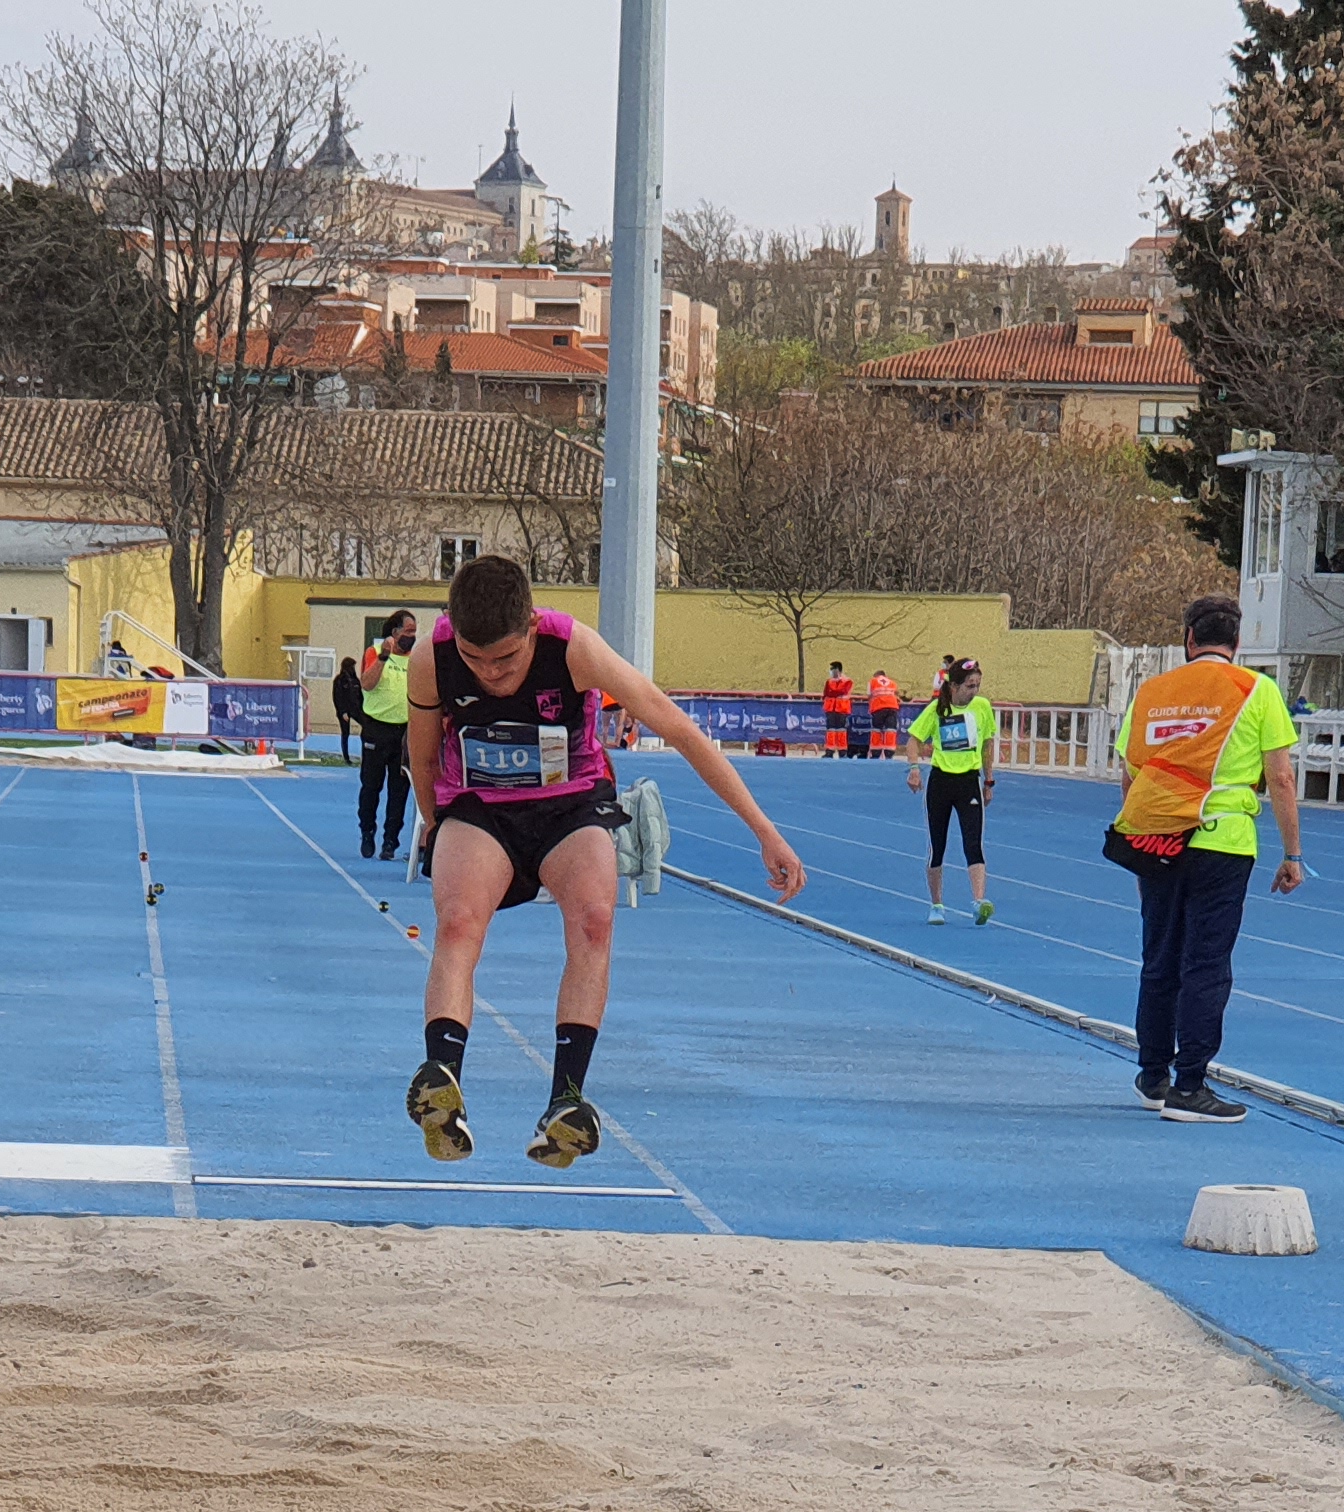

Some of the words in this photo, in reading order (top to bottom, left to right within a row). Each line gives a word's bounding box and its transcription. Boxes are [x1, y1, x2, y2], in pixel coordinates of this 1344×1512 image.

[78, 688, 148, 709] campeonato
[246, 702, 276, 714] Liberty
[1148, 707, 1179, 718] GUIDE
[1180, 705, 1222, 716] RUNNER
[946, 726, 960, 738] 26
[476, 747, 529, 769] 110
